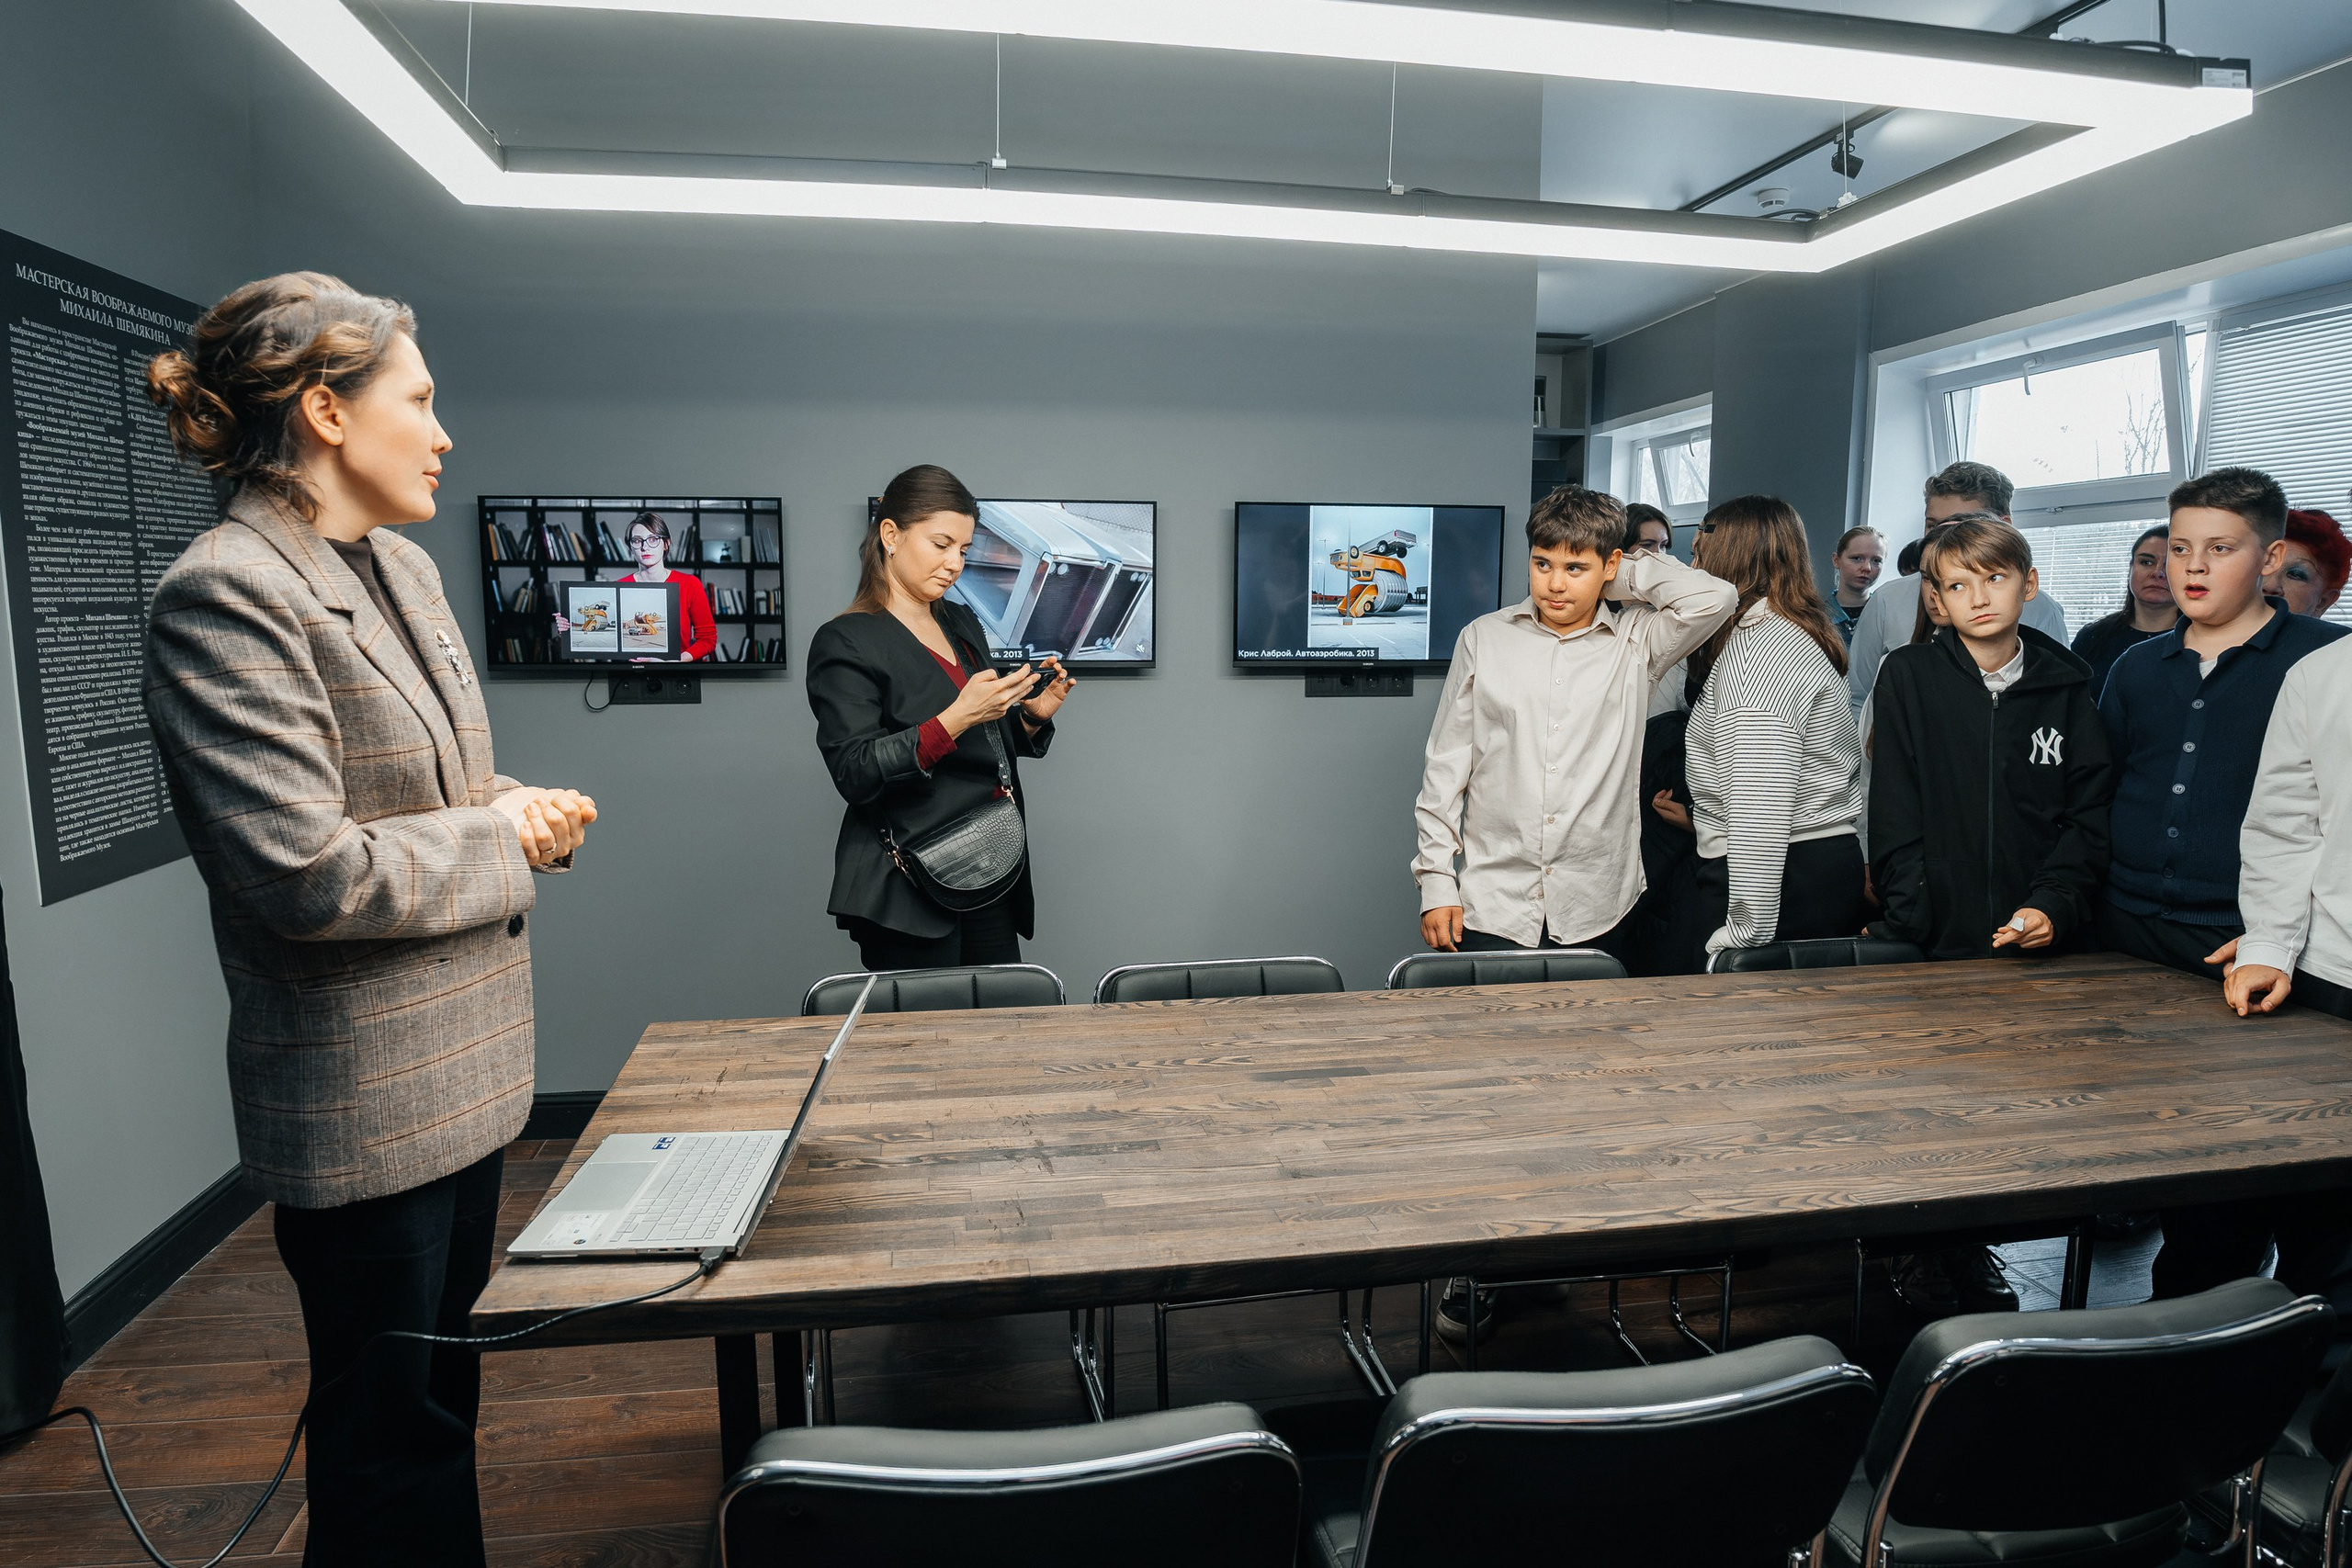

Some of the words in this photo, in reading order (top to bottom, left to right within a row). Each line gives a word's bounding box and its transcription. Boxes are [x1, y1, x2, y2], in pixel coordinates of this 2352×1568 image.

[16, 263, 89, 300] МАСТЕРСКАЯ
[91, 289, 172, 328] ВООБРАЖАЕМОГО
[173, 318, 198, 337] МУЗЕ
[59, 299, 113, 327] МИХАИЛА
[116, 316, 171, 346] ШЕМЯКИНА
[1003, 650, 1023, 659] 2013
[1238, 649, 1259, 659] Крис
[1260, 649, 1294, 659] Лаброй.
[1295, 649, 1355, 659] Автоаэробика.
[1356, 649, 1375, 658] 2013
[2029, 727, 2064, 766] NY
